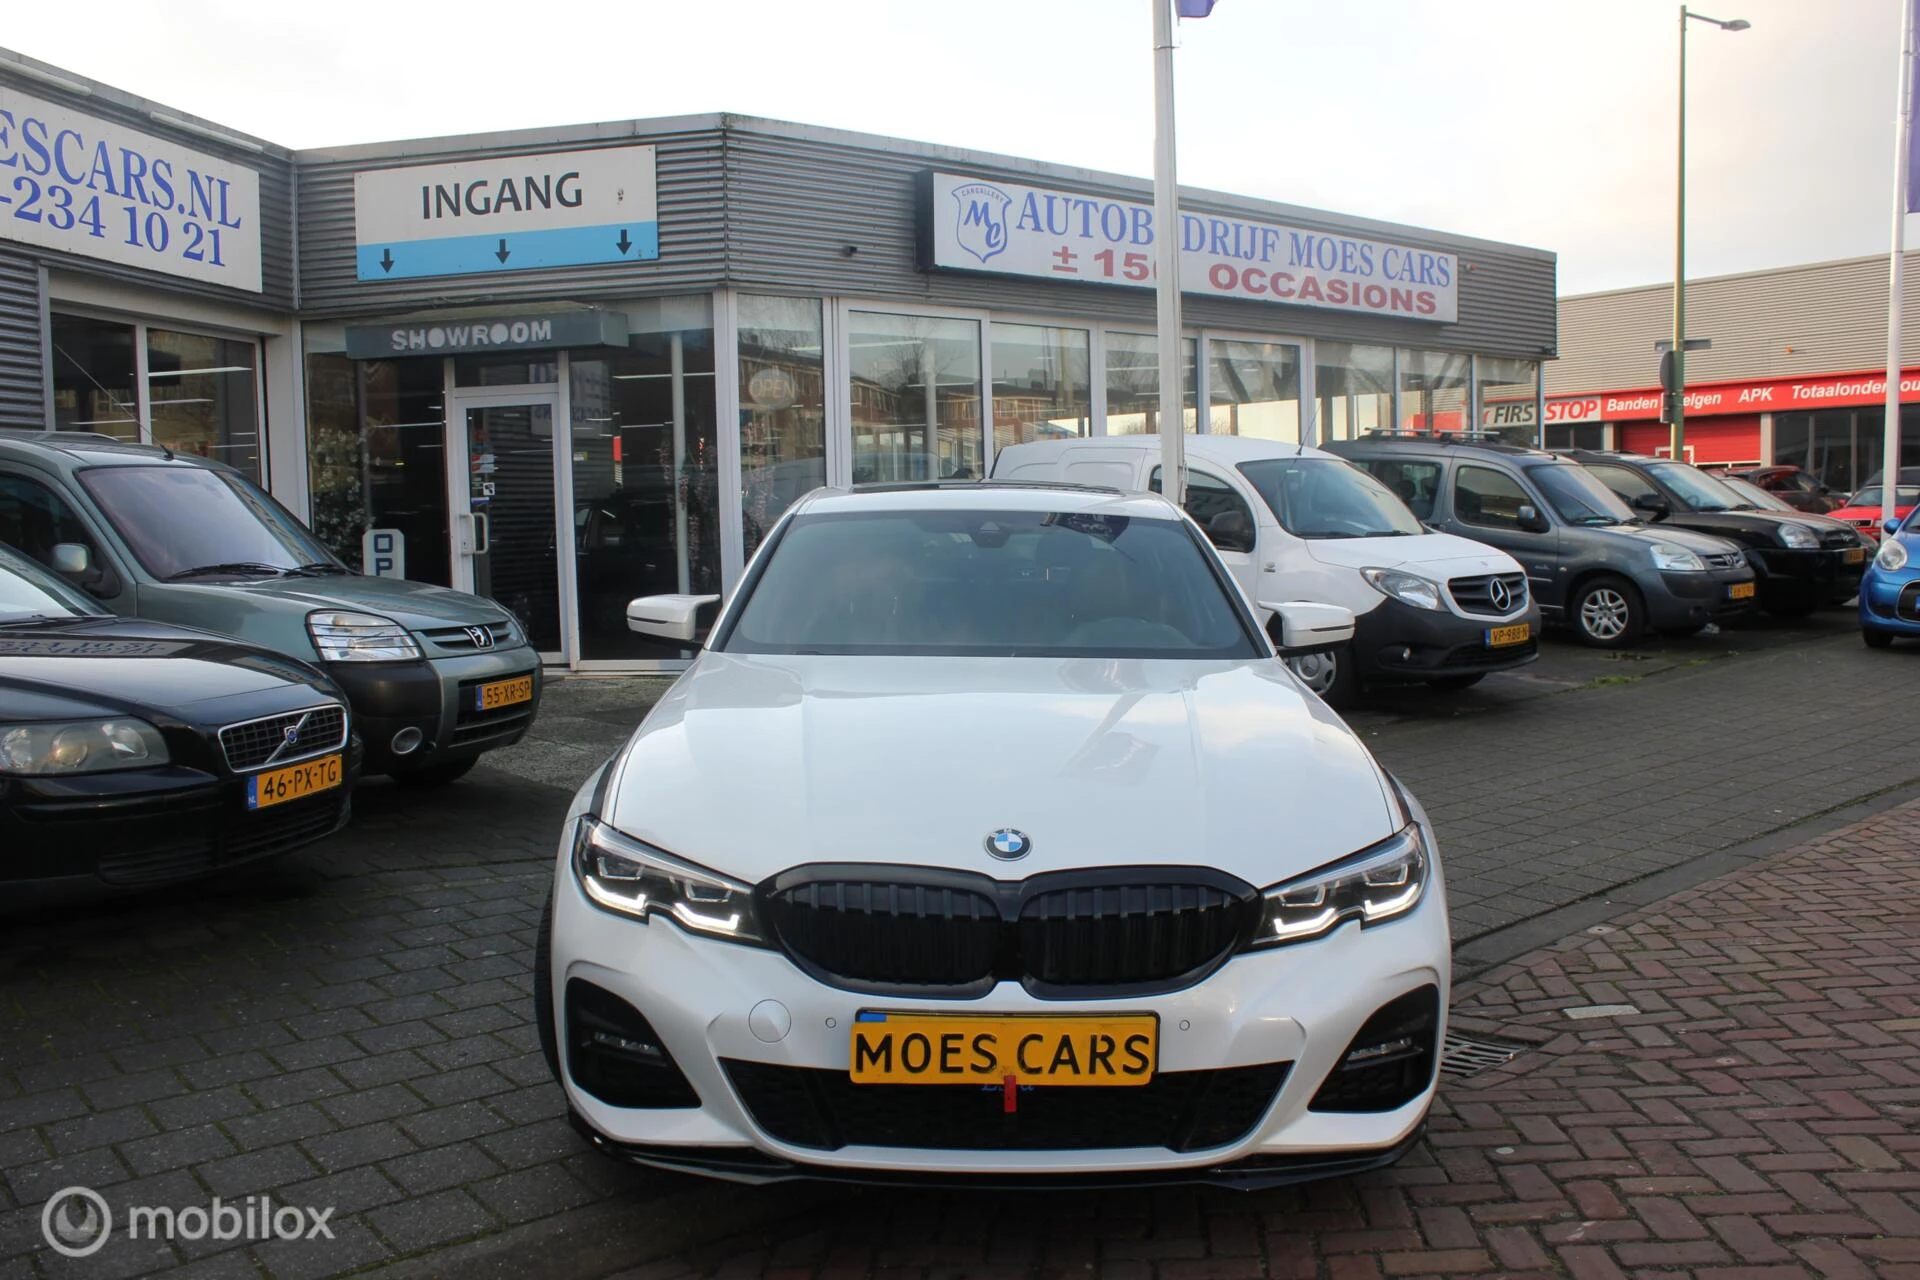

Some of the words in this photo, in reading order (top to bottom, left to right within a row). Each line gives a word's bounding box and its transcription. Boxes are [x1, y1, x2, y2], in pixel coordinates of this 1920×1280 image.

[422, 172, 582, 220] INGANG
[123, 206, 169, 252] 10
[183, 221, 225, 267] 21
[1016, 191, 1280, 263] AUTOBDRIJF
[1288, 232, 1374, 277] MOES
[1382, 247, 1451, 288] CARS
[1094, 248, 1158, 281] 15
[1208, 263, 1437, 315] OCCASIONS
[391, 319, 552, 350] SHOWROOM
[749, 379, 796, 399] OPEN
[1607, 396, 1658, 412] Banden
[1682, 392, 1721, 410] elgen
[1738, 387, 1773, 403] APK
[1792, 379, 1920, 399] Totaalonderou
[1494, 404, 1534, 424] FIRS
[1544, 400, 1598, 420] STOP
[486, 681, 531, 706] 55-XR-SP
[264, 760, 337, 800] 46-PX-TG
[856, 1033, 998, 1073] MOES
[1016, 1033, 1150, 1075] CARS
